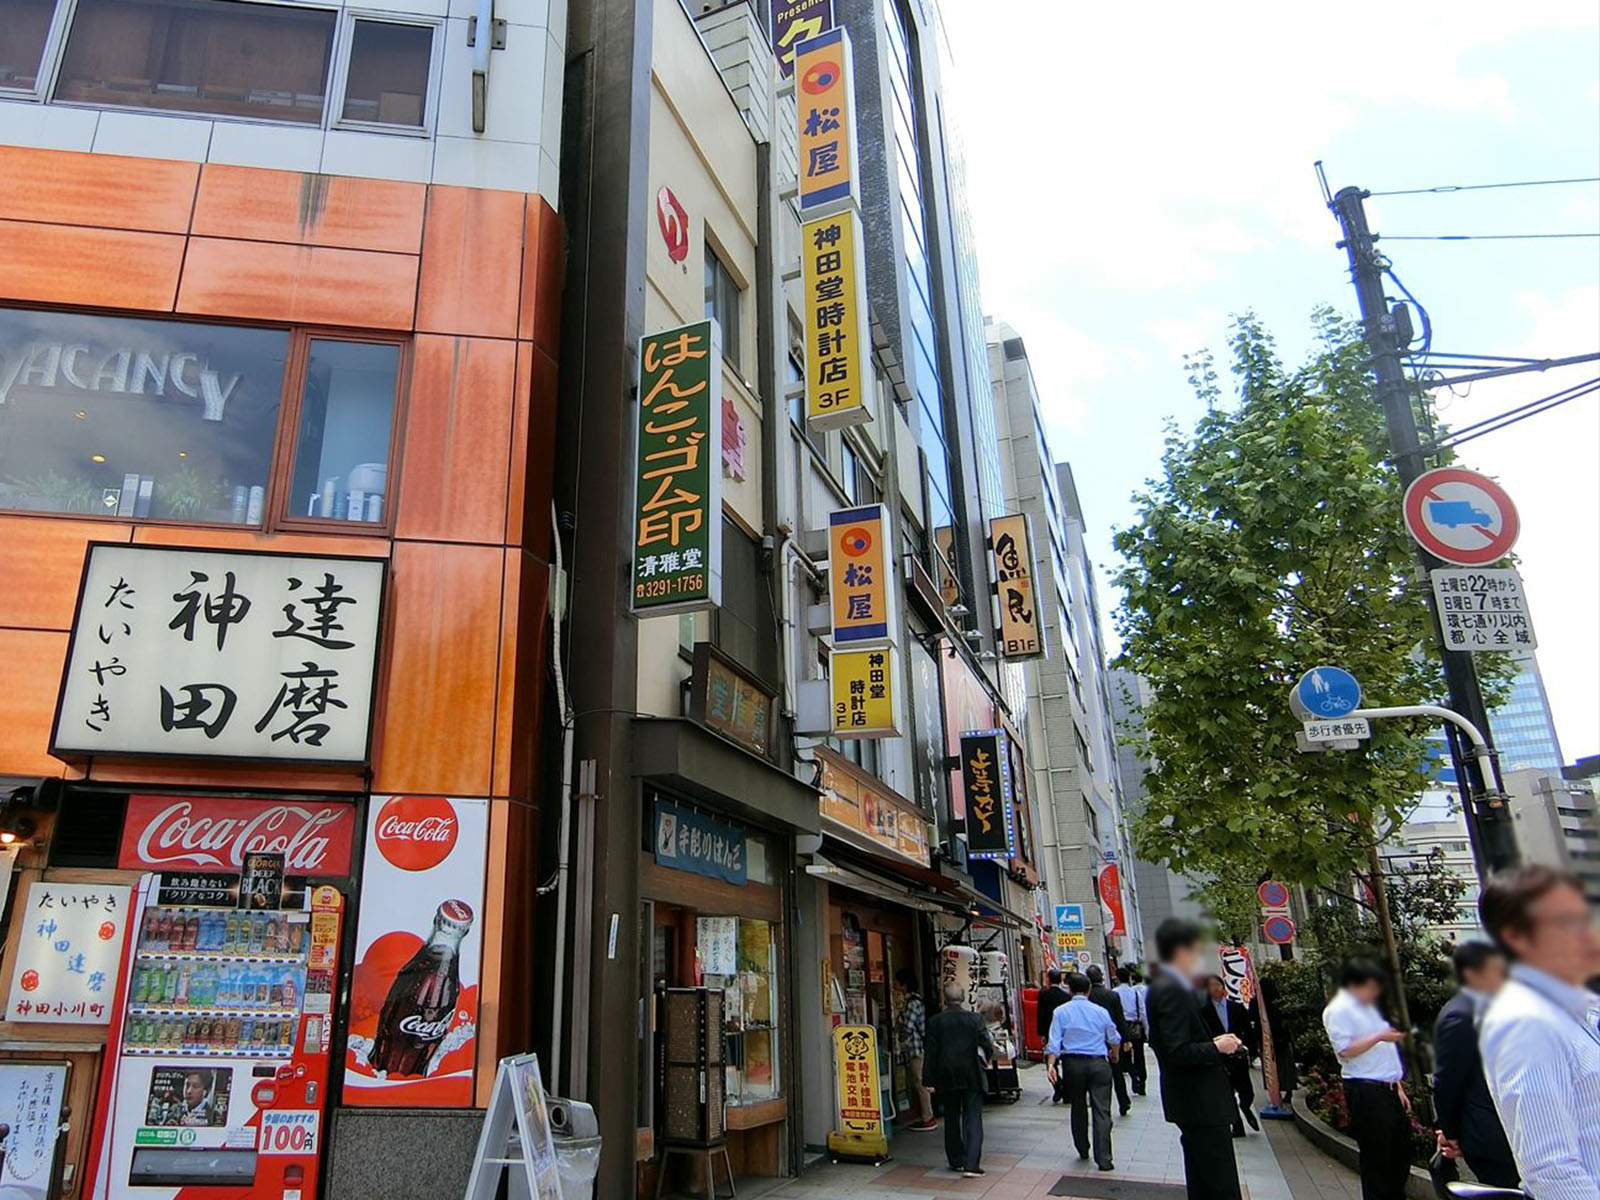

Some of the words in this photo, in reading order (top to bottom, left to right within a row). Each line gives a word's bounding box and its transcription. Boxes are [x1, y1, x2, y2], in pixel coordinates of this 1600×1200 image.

[803, 107, 841, 178] 松屋
[813, 224, 847, 386] 神田堂時計店
[818, 388, 850, 409] 3F
[637, 332, 707, 547] はんこ・ゴム印
[638, 548, 703, 578] 清雅堂
[645, 575, 703, 598] 3291-1756
[843, 563, 873, 620] 松屋
[1440, 575, 1517, 593] 土曜日22時から
[1444, 593, 1521, 610] 日曜日7時まで
[1446, 614, 1527, 629] 環七通り以内
[1008, 639, 1035, 652] B1F
[1450, 629, 1531, 644] 都心全域
[85, 576, 136, 733] たいやき
[159, 570, 252, 739] 神田
[254, 572, 358, 747] 達磨
[868, 653, 886, 699] 神田堂
[836, 702, 847, 728] 3F
[850, 680, 866, 726] 時計店
[1309, 723, 1366, 737] 歩行者優先
[137, 801, 347, 868] Coca-Cola
[378, 814, 456, 842] Coca-Cola
[170, 877, 228, 888] 飲み飽きない
[241, 877, 281, 895] BLACK
[251, 869, 275, 878] DEEP
[38, 891, 117, 911] たいやき
[37, 918, 106, 992] 神田達磨
[16, 1002, 105, 1017] 神田小川町
[262, 1124, 305, 1150] 100
[865, 1122, 876, 1130] 3F
